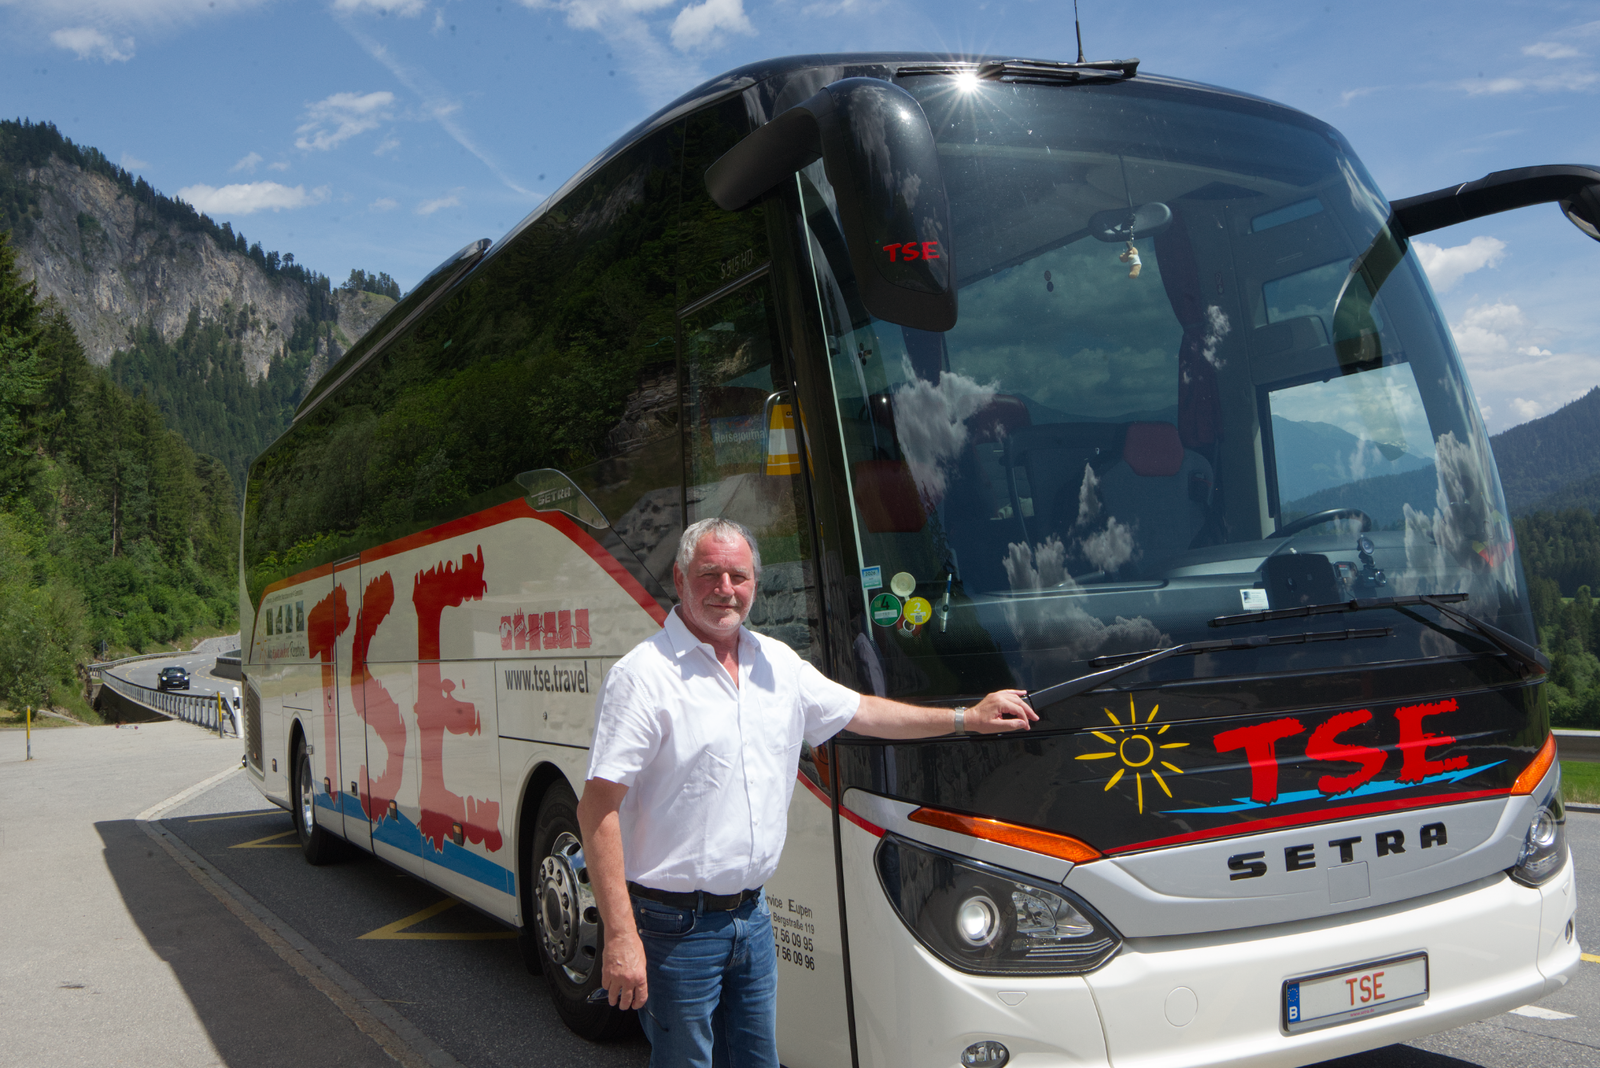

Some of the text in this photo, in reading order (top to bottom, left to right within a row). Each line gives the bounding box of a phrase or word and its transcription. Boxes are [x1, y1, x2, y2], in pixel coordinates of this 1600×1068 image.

[883, 241, 940, 262] TSE
[714, 427, 768, 445] Reisejournal
[537, 487, 571, 506] SETRA
[881, 595, 889, 610] 4
[914, 602, 921, 612] 2
[505, 661, 589, 693] www.tse.travel
[307, 544, 503, 853] TSE
[1213, 698, 1469, 805] TSE
[1227, 821, 1448, 882] SETRA
[788, 898, 813, 919] Eupen
[773, 912, 815, 934] Bergstraße 119
[781, 928, 790, 943] 56
[792, 933, 801, 948] 09
[803, 937, 813, 952] 95
[782, 947, 791, 962] 56
[793, 951, 803, 966] 09
[805, 955, 815, 970] 96
[1345, 971, 1385, 1006] TSE
[1289, 1006, 1298, 1019] B
